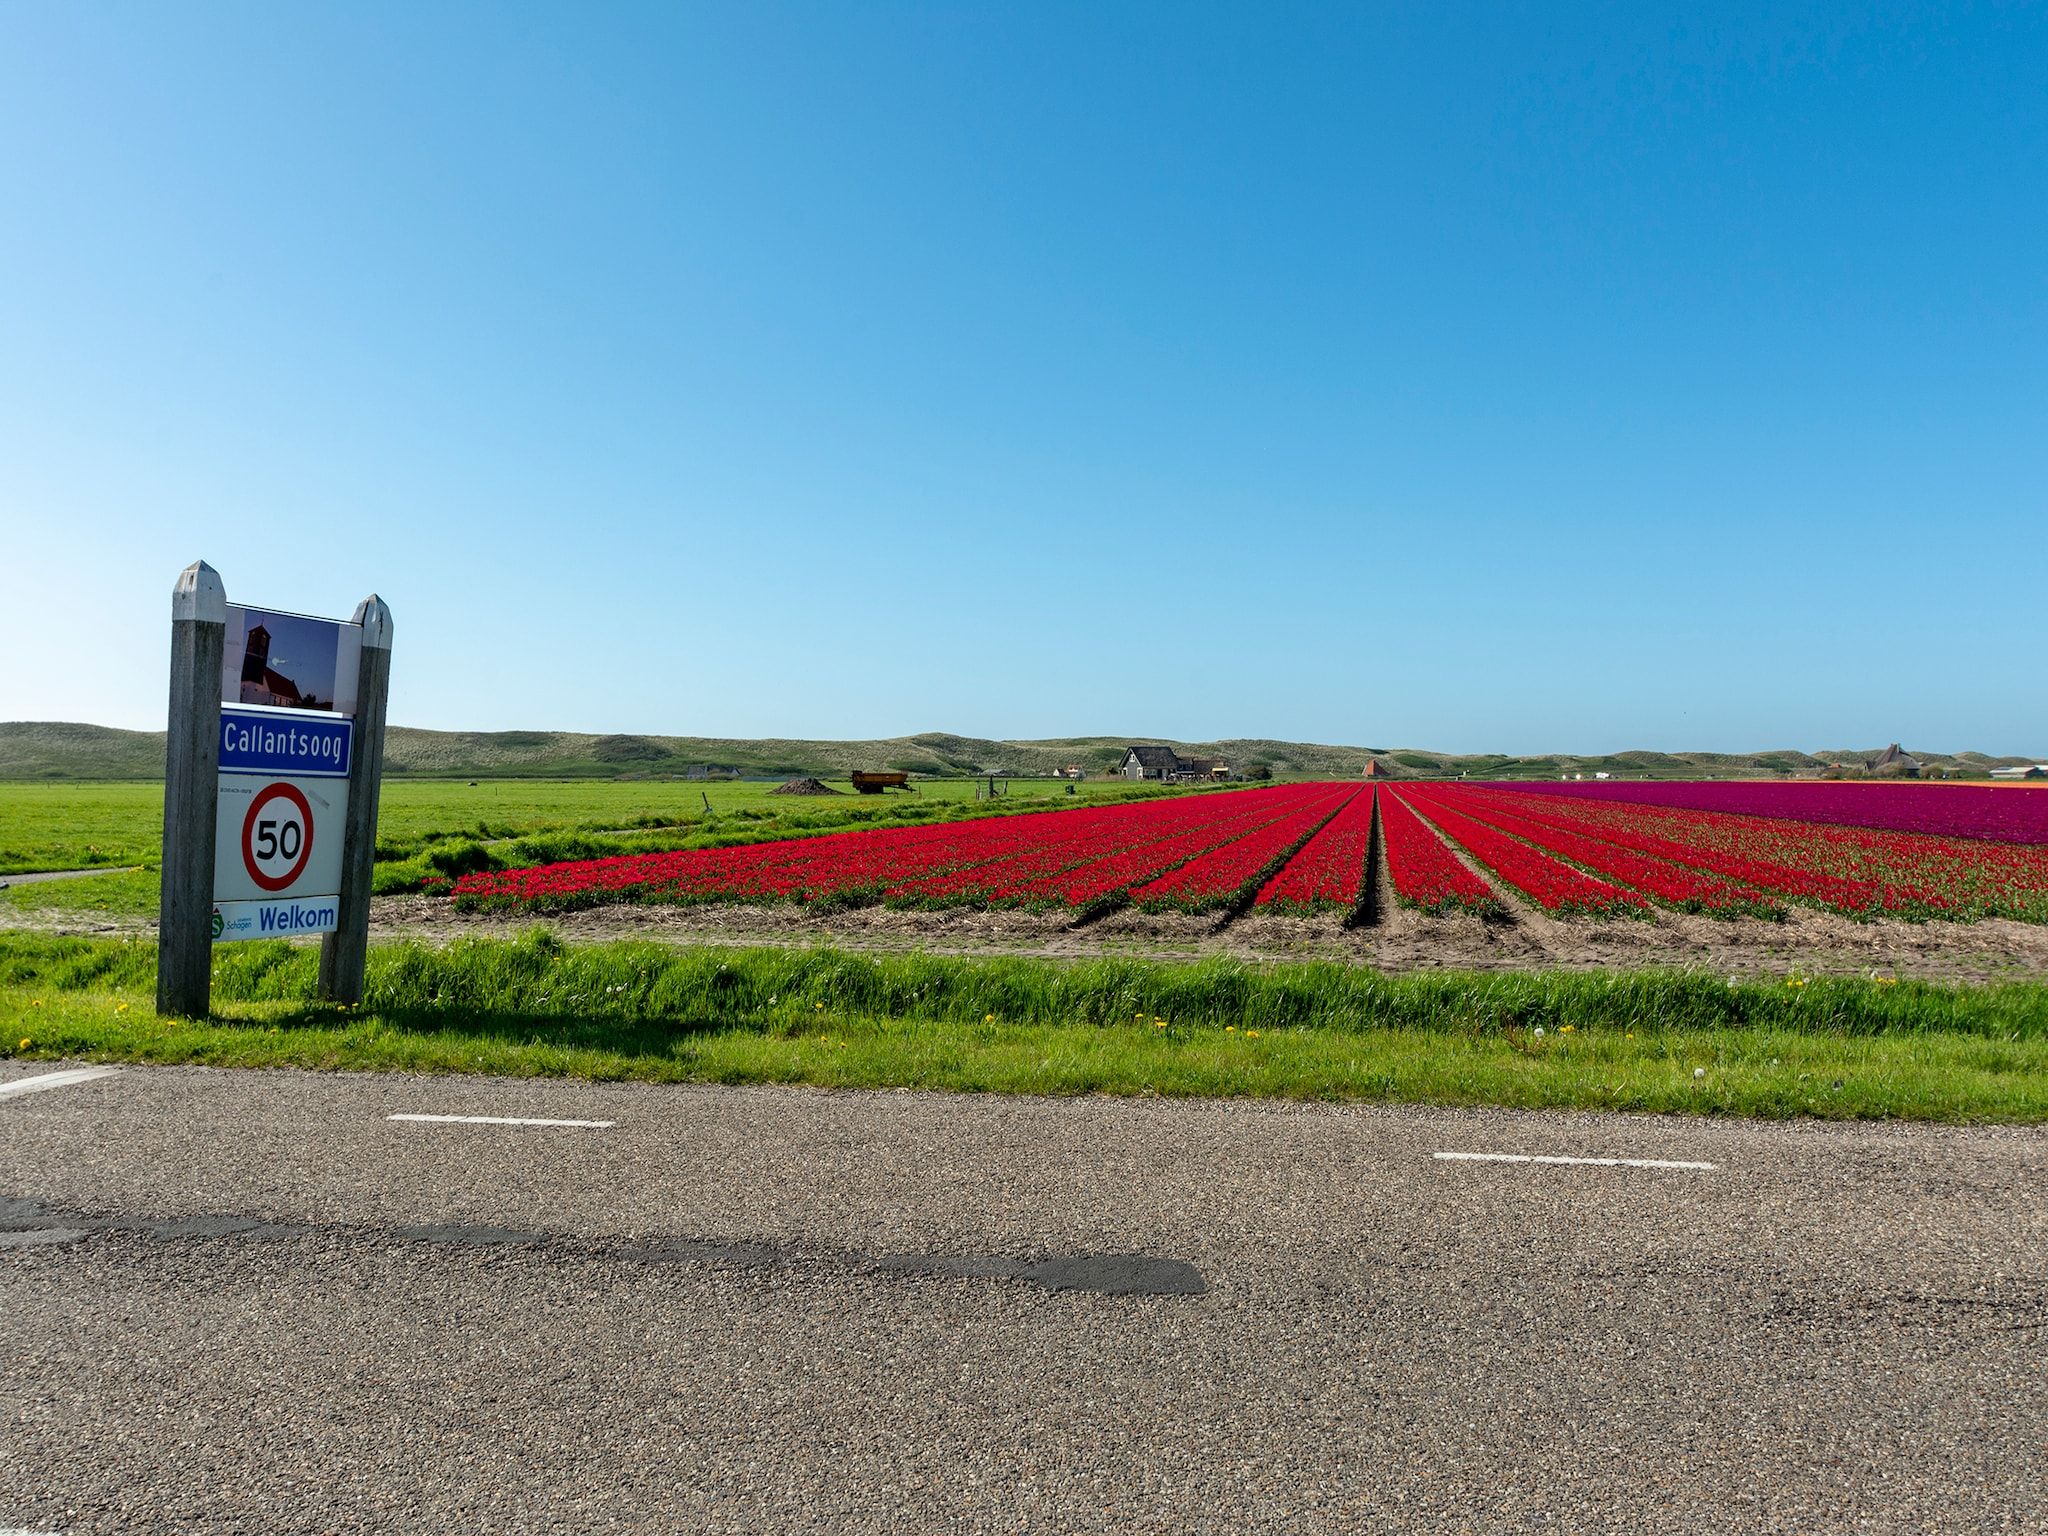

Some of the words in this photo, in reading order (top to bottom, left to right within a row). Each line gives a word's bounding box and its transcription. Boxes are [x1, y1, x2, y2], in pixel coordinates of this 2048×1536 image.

[224, 722, 342, 765] Callantsoog
[256, 820, 301, 860] 50
[226, 920, 252, 931] Schagen
[260, 905, 334, 931] Welkom
